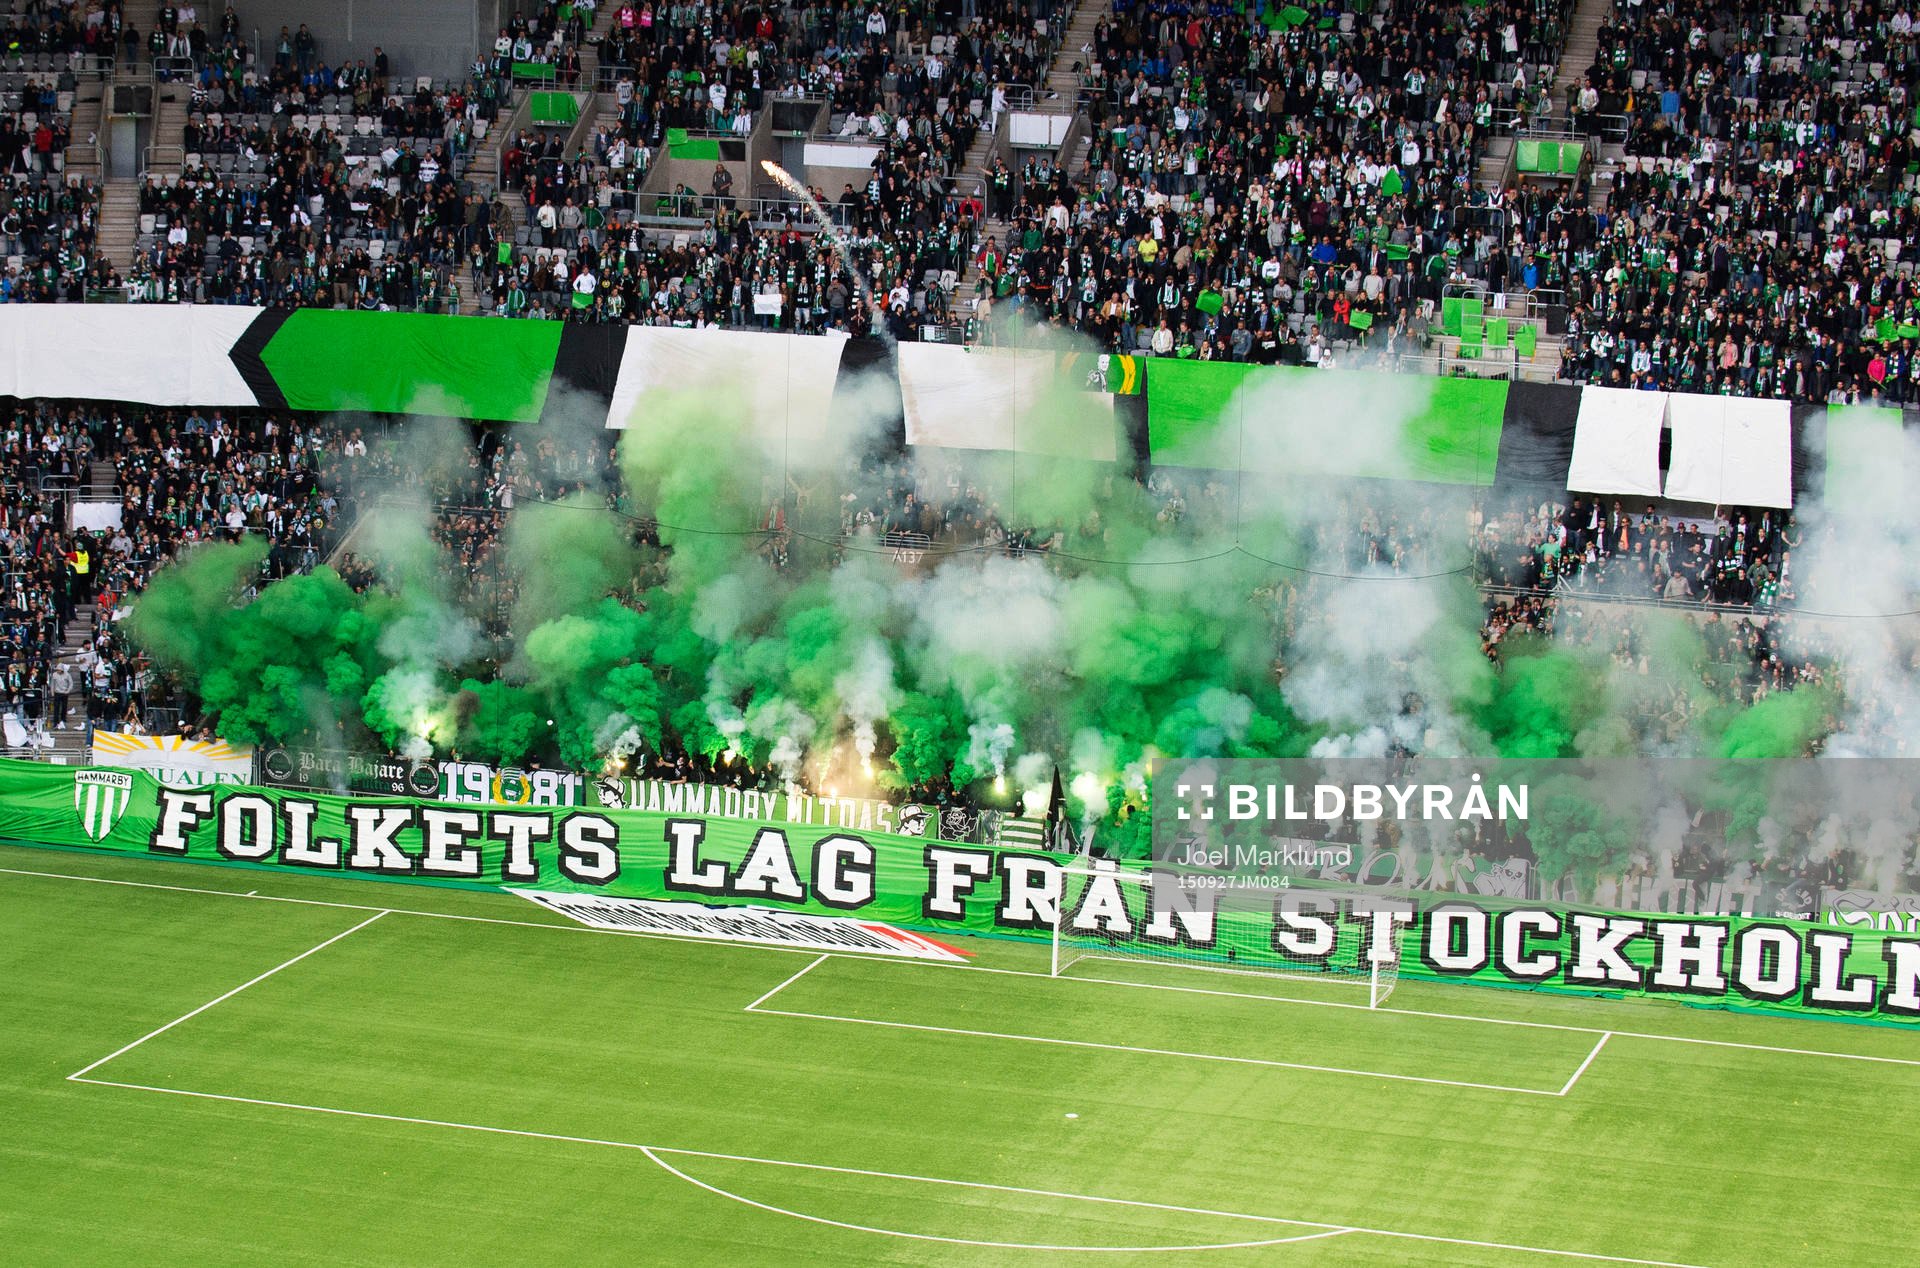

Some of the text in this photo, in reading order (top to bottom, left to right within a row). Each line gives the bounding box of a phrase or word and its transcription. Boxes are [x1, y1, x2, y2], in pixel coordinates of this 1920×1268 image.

[892, 550, 923, 563] A137
[76, 772, 130, 787] HAMMARBY
[391, 782, 405, 793] 96
[149, 786, 622, 885] FOLKETS
[663, 818, 876, 909] LAG
[922, 843, 1222, 949] FRÅN
[761, 915, 902, 950] fotboll
